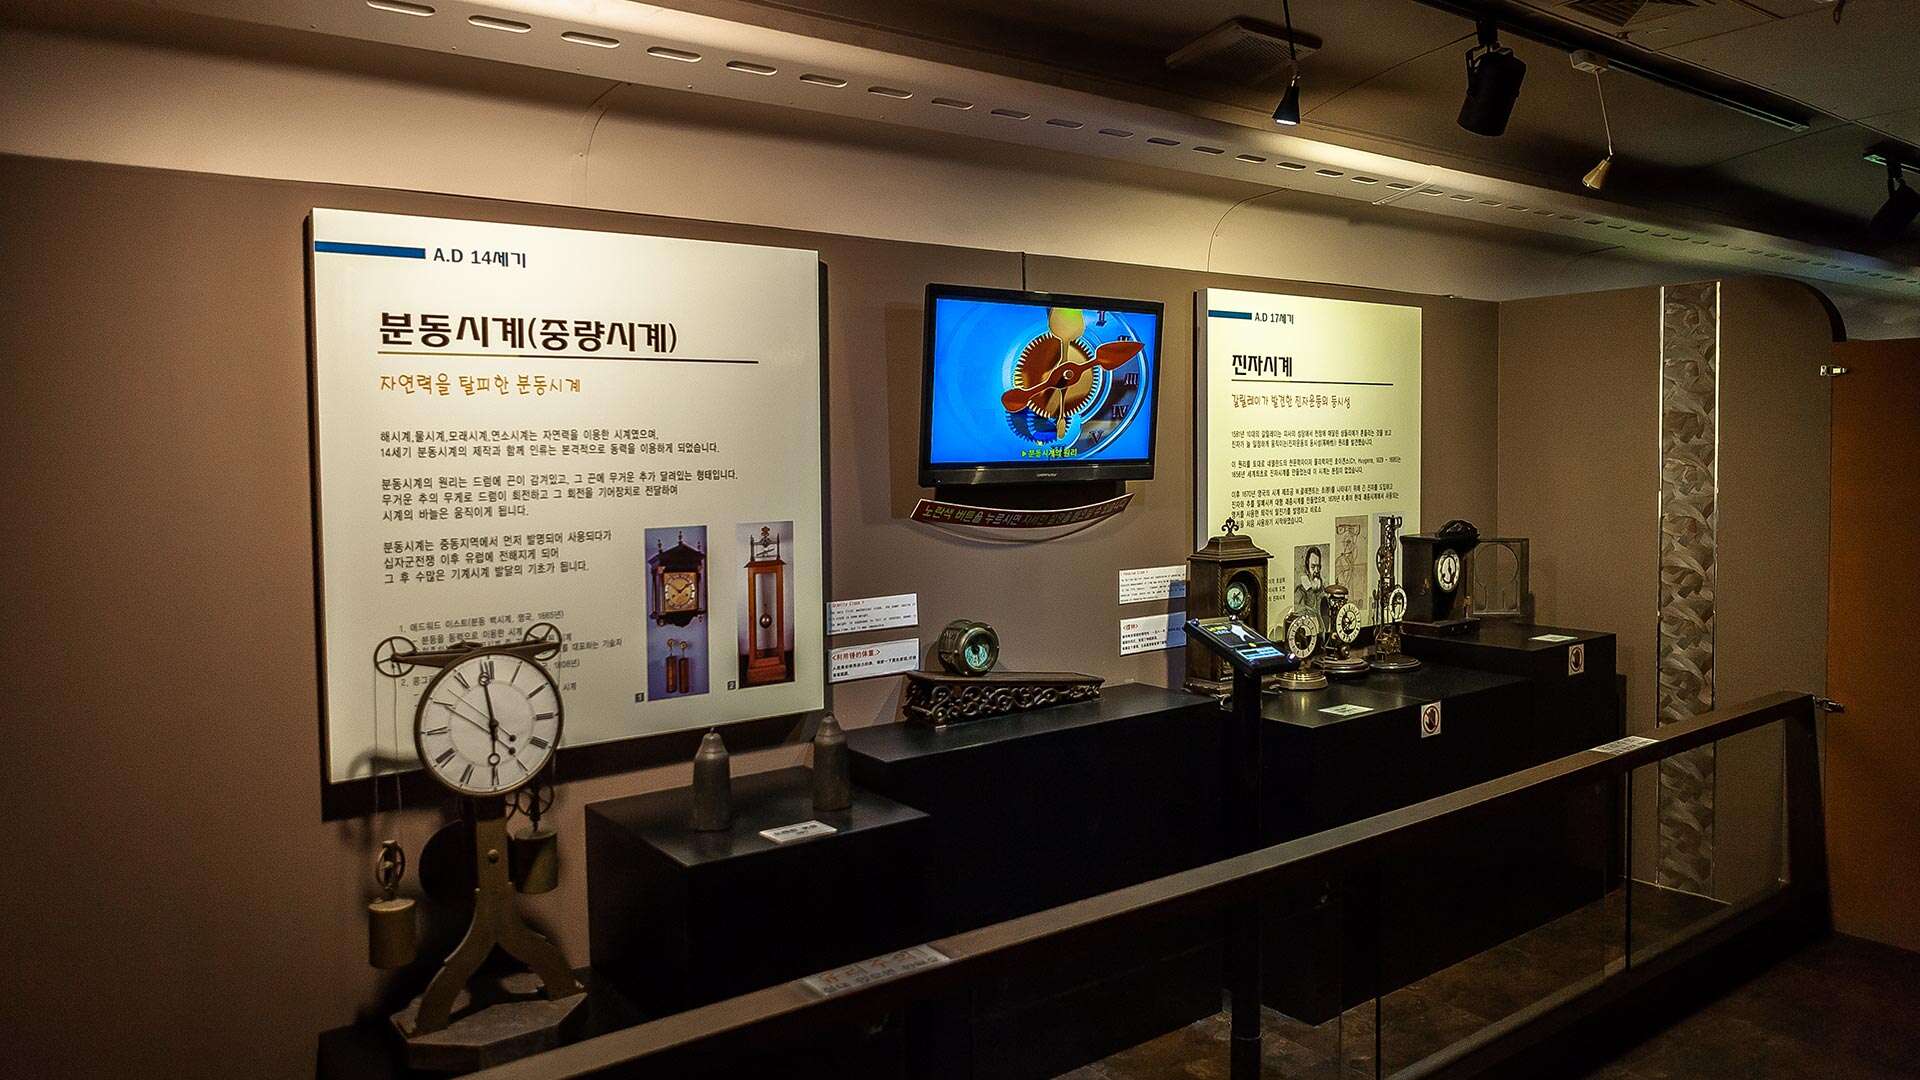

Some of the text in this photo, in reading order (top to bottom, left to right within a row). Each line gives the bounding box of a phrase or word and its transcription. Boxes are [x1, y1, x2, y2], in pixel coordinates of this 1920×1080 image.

[433, 247, 527, 269] A.D 14세기
[1254, 313, 1294, 325] A.D 17세기
[379, 312, 677, 354] 분동시계(중량시계)
[1231, 355, 1293, 377] 진자시계
[379, 374, 581, 396] 자연력을 탈피한 분동시계
[1271, 394, 1293, 409] 발견한
[1294, 394, 1329, 409] 진자운동의
[543, 429, 579, 441] 자연력을
[583, 429, 610, 441] 이용한
[380, 442, 720, 458] 14세기 분동시계의 제작과 함께 인류는 본격적으로 동력을 이용하게 되었습니다.
[382, 477, 433, 490] 분동시계의
[438, 476, 468, 489] 원리는
[473, 475, 501, 488] 드럼에
[574, 473, 583, 485] 그
[609, 472, 635, 484] 무거운
[639, 471, 656, 483] 추가
[660, 471, 692, 483] 달려있는
[382, 484, 678, 506] 무거운 추의 무게로 드럼이 회전하고 그 회전을 기어장치로 전달하여
[383, 505, 529, 522] 시계의 바늘은 움직이게 됩니다.
[384, 530, 612, 553] 분동시계는 중동지역에서 먼저 발명되어 사용되다가
[384, 547, 559, 569] 십자군전쟁 이후 유럽에 전해지게 되어
[384, 560, 589, 584] 그 후 수많은 기계시계 발달의 기초가 됩니다.
